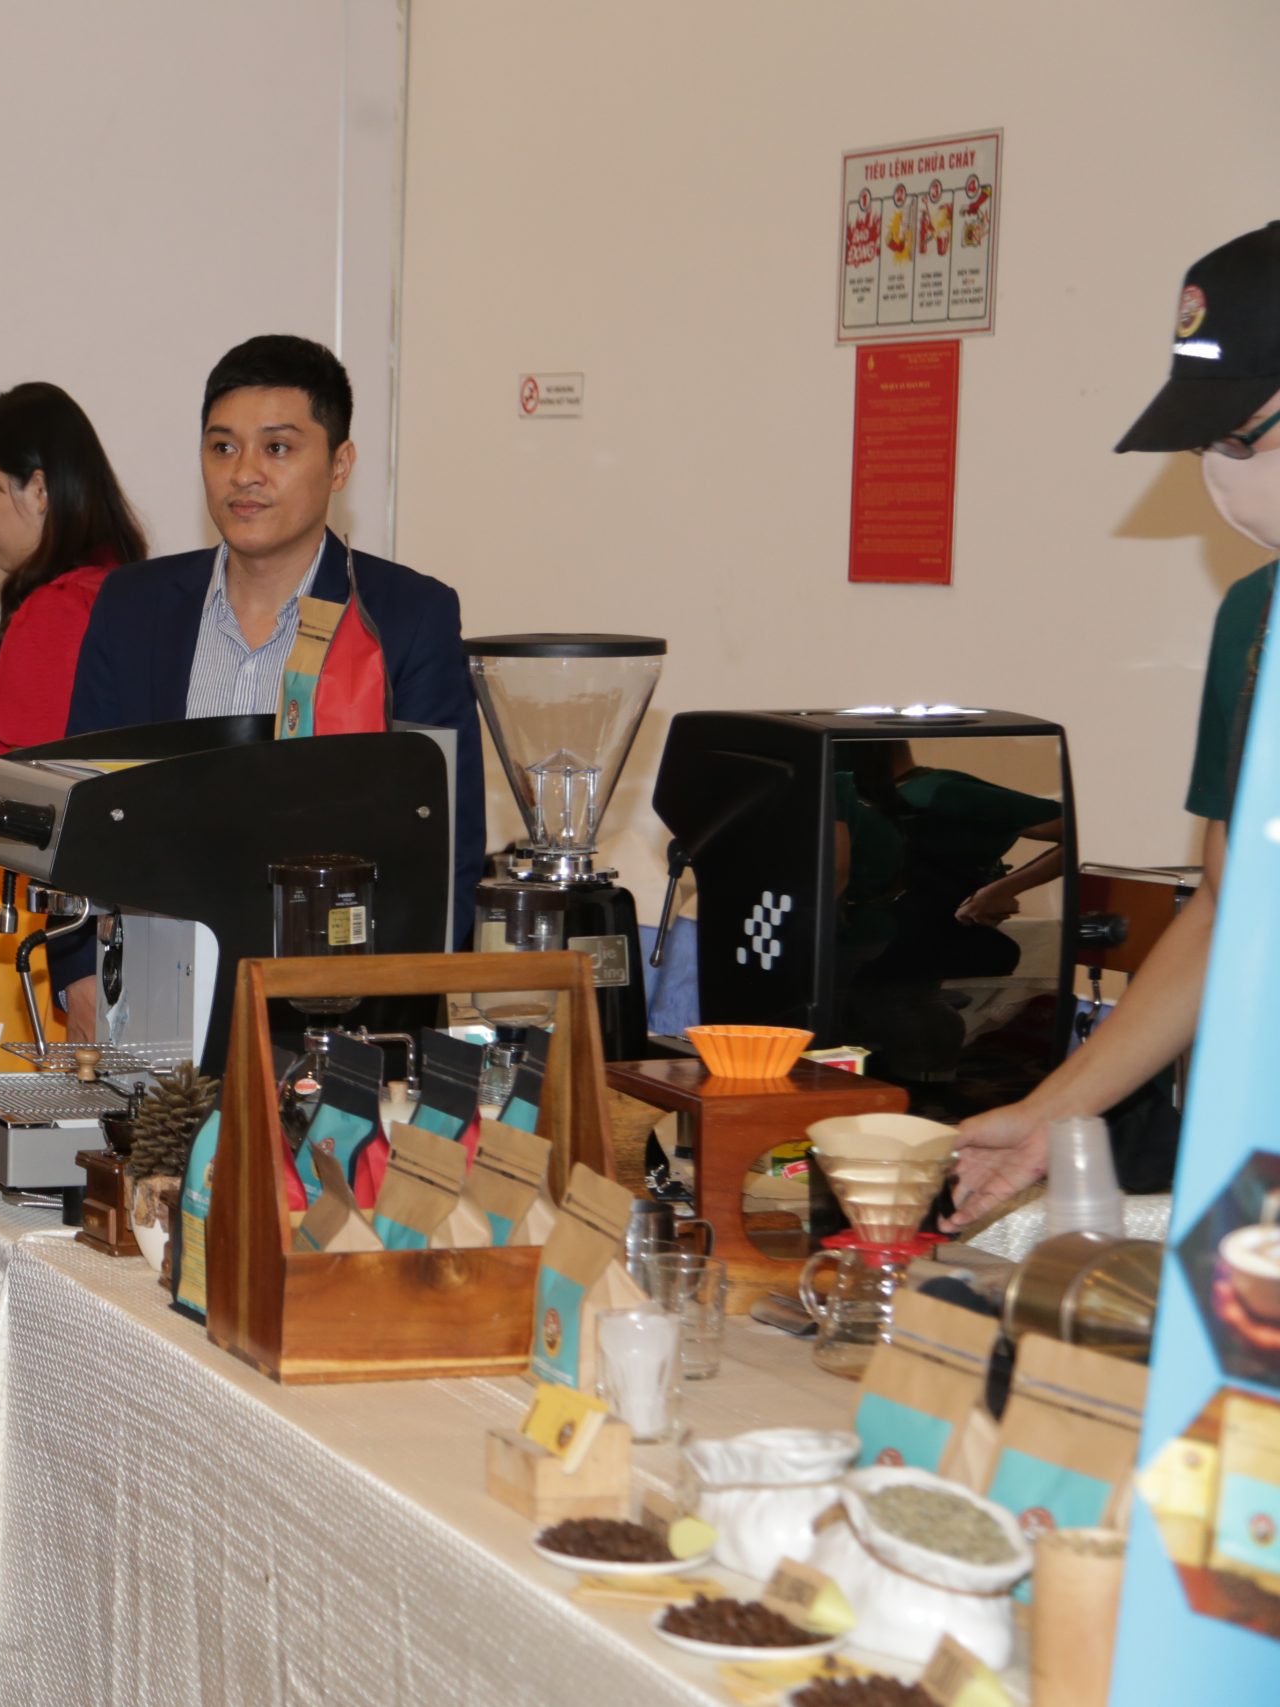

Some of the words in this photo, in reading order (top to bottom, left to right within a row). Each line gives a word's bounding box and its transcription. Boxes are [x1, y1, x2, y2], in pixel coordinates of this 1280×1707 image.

[932, 184, 939, 196] 3
[968, 179, 976, 193] 4
[896, 186, 904, 204] 2
